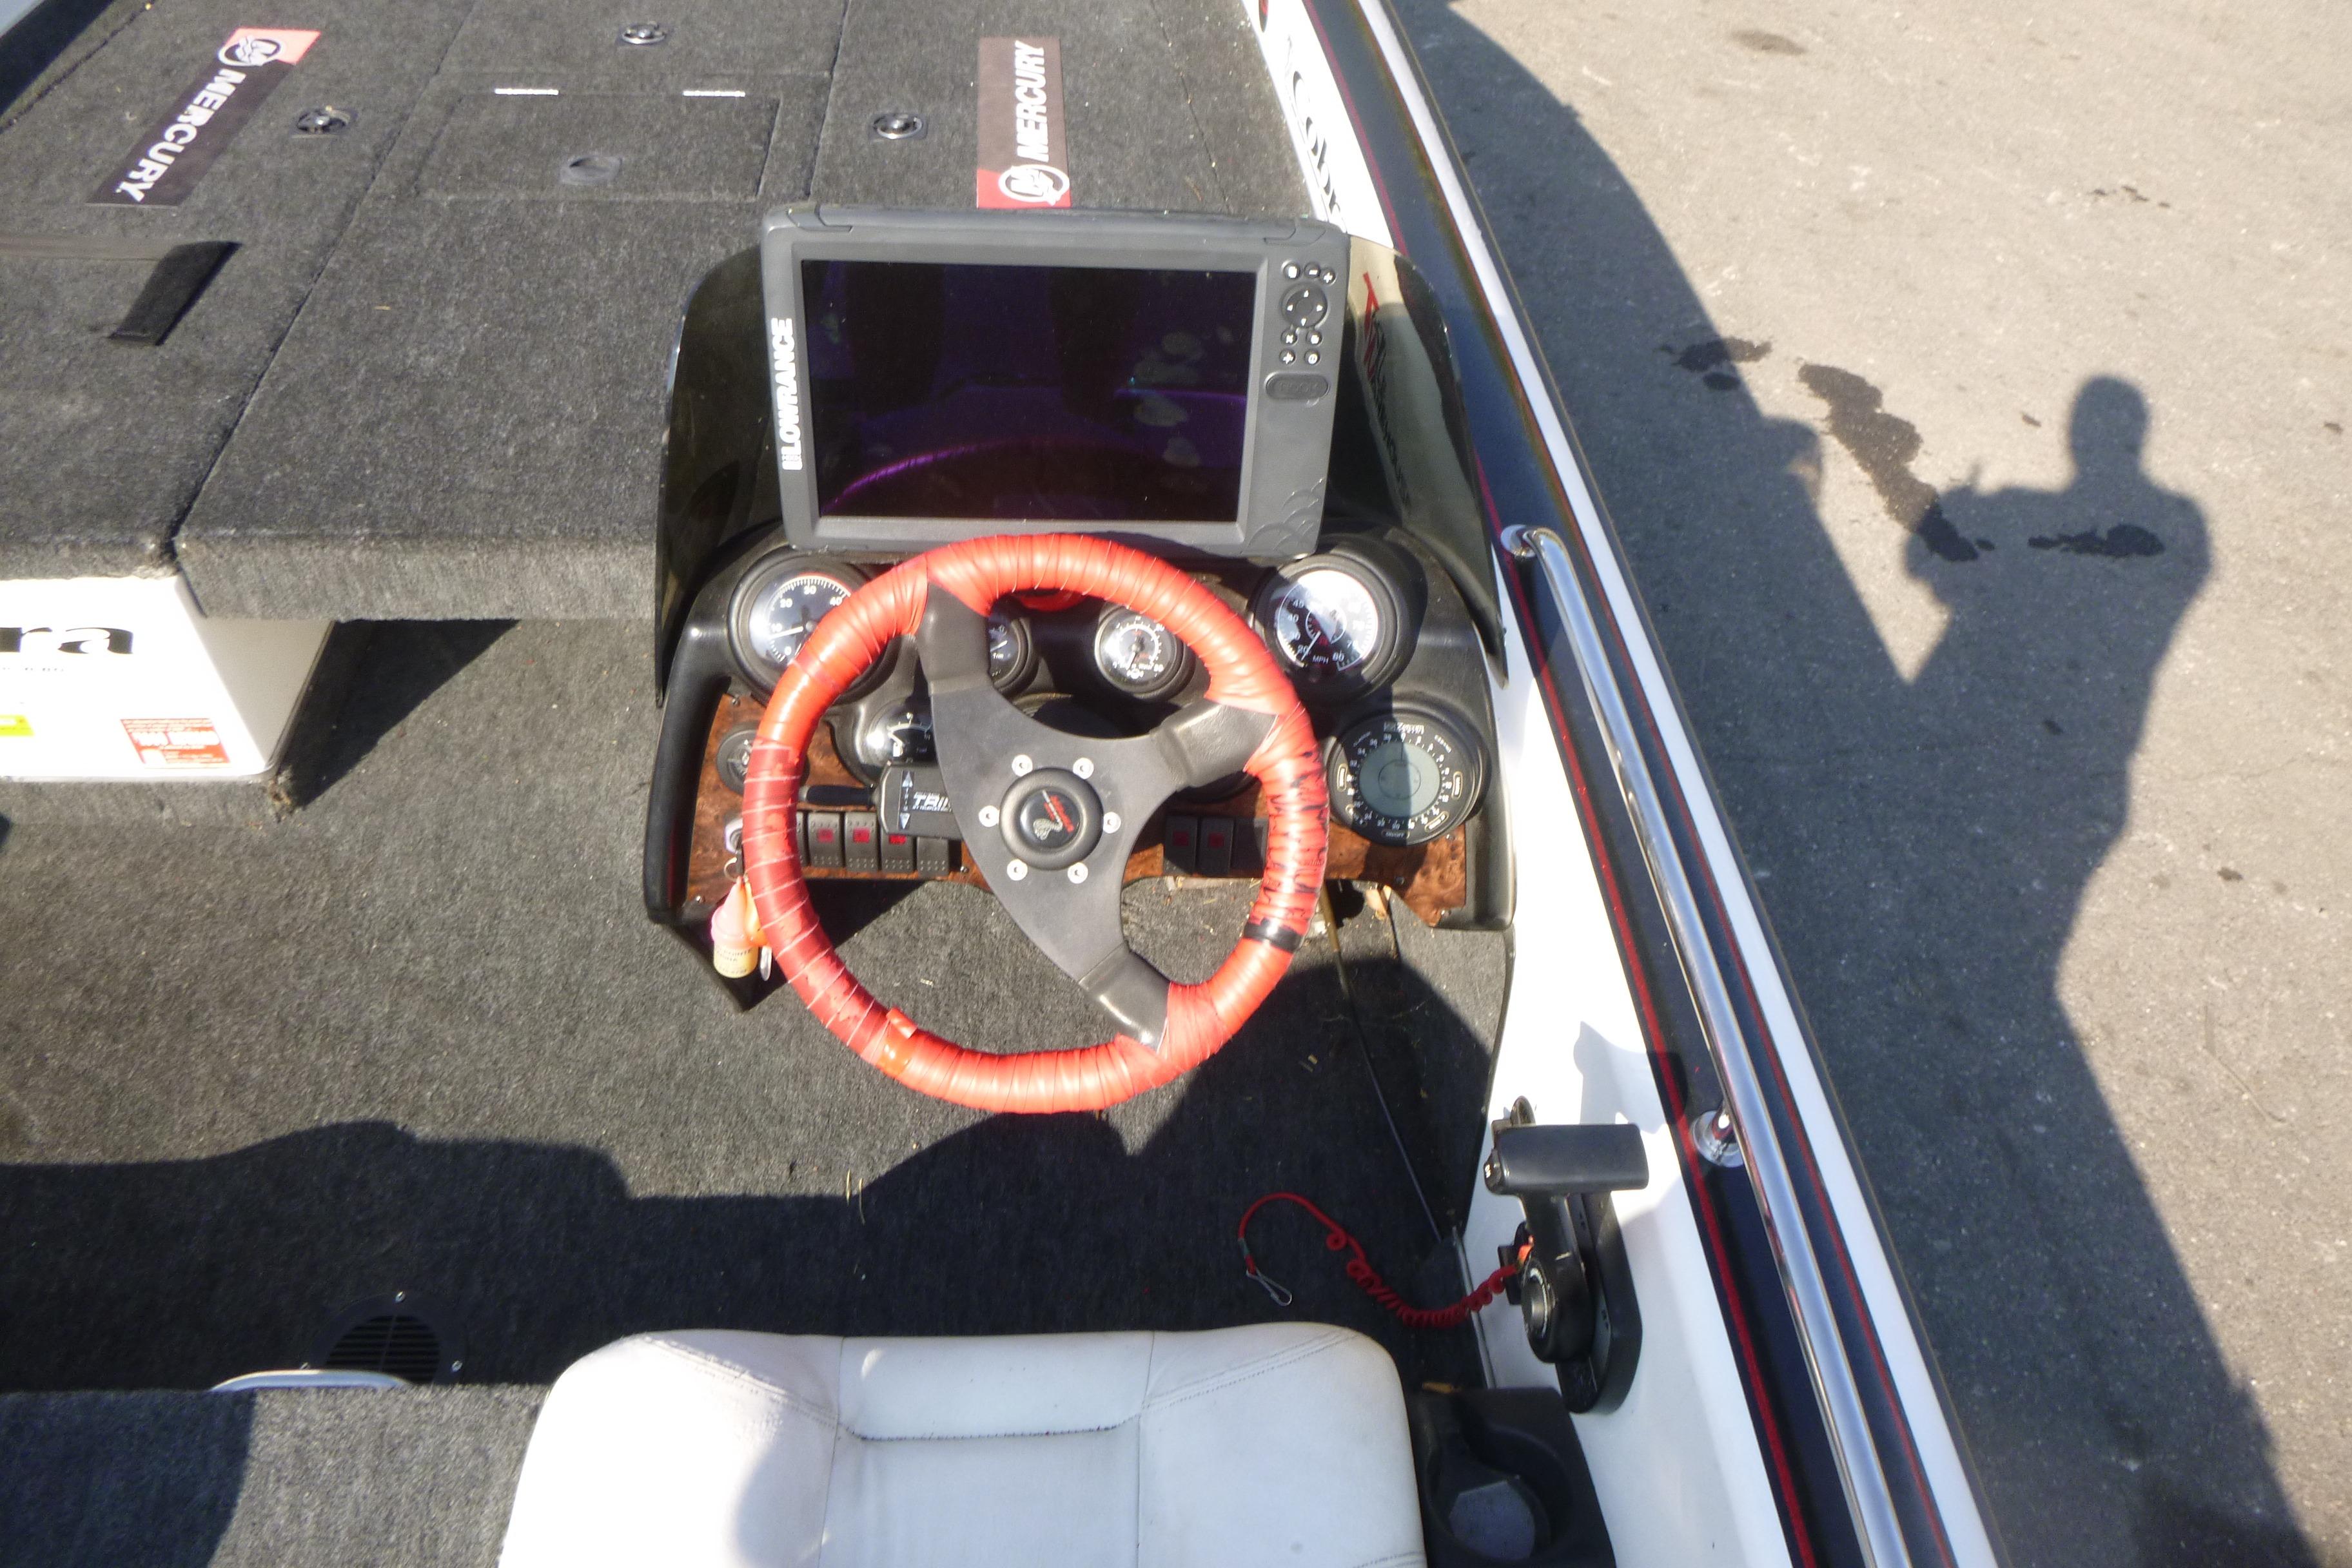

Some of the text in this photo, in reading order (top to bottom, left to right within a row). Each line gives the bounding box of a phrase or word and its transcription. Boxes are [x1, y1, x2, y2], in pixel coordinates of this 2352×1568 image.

[116, 68, 246, 201] MERCURY
[1015, 40, 1047, 162] MERCURY
[771, 318, 801, 455] LOWRANCE
[1312, 654, 1329, 663] MPH
